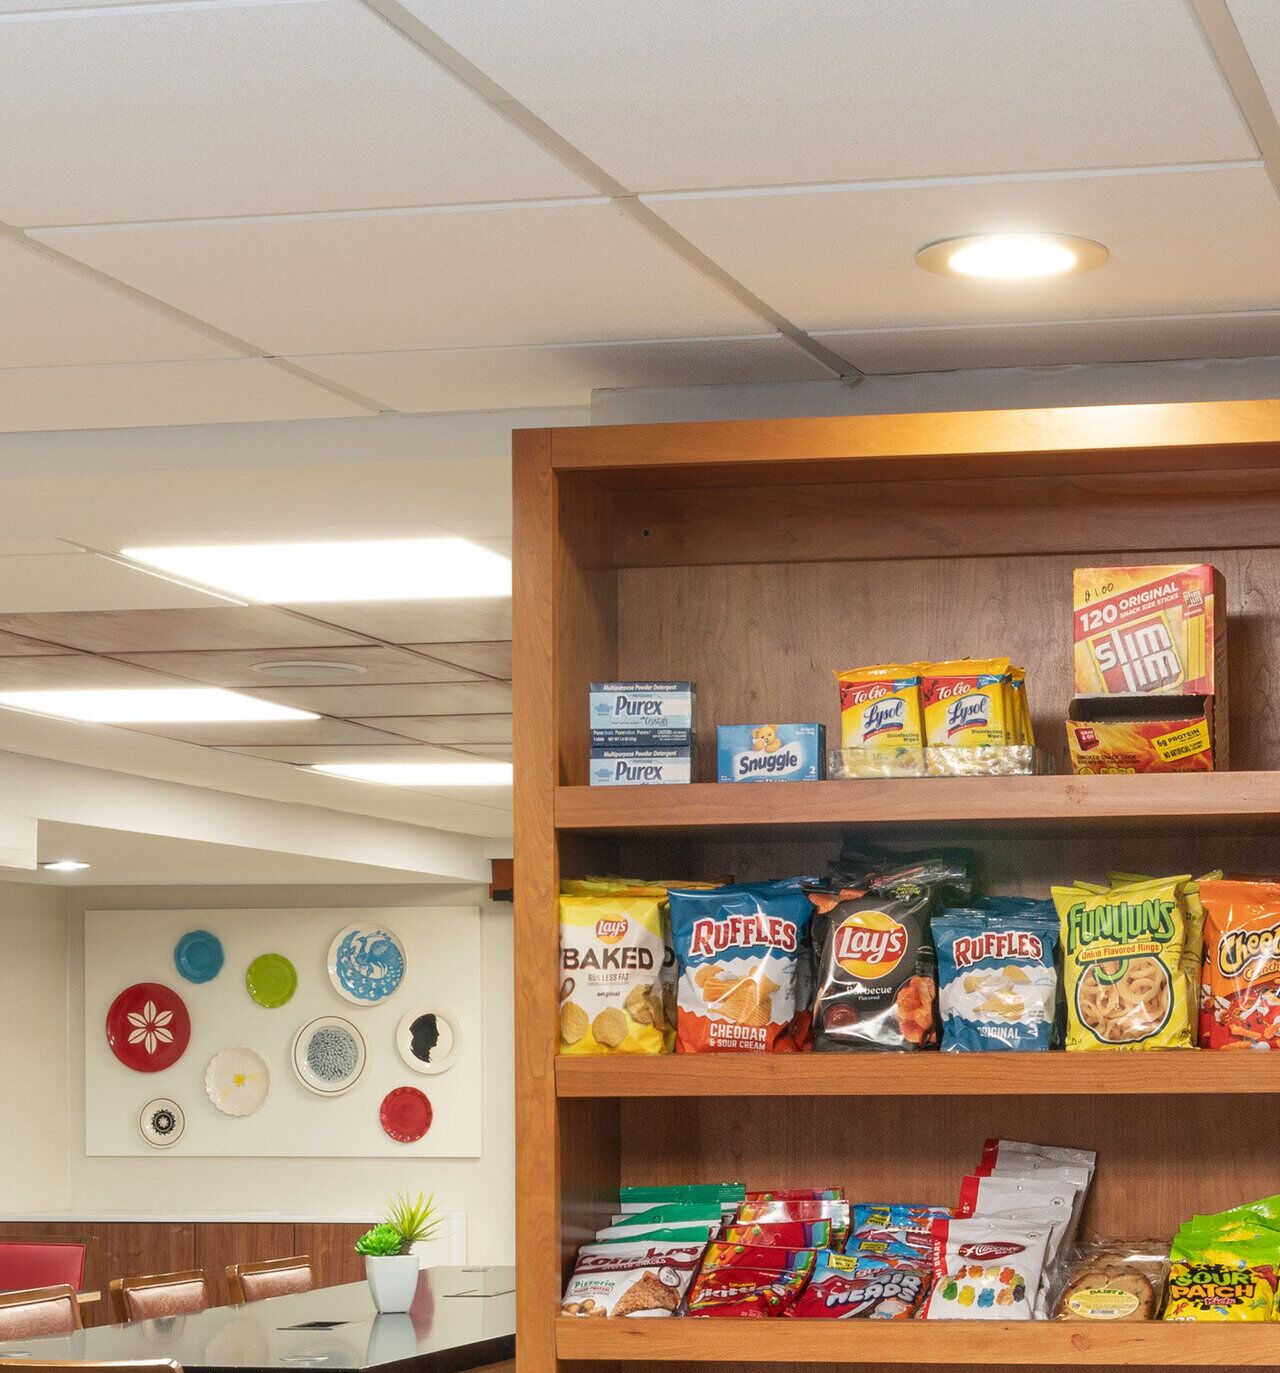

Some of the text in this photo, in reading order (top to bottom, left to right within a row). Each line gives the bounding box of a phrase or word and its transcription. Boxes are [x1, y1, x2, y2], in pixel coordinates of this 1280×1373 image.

[1079, 604, 1118, 632] 120
[1119, 582, 1179, 610] ORIGINAL
[852, 686, 887, 704] To Go
[936, 681, 971, 701] To Go
[615, 695, 662, 715] Purex
[863, 700, 904, 729] Lysol
[947, 696, 988, 725] Lysol
[1168, 728, 1200, 743] PROTEIN
[615, 761, 662, 781] Purex
[739, 750, 798, 775] Snuggle
[597, 917, 628, 937] Lay's
[689, 913, 797, 957] RUFFLES
[838, 927, 904, 964] Lay's
[954, 931, 1043, 970] RUFFLES
[1103, 945, 1137, 957] Flavored
[1138, 942, 1159, 954] Rings
[563, 947, 654, 970] BAKED
[602, 973, 616, 982] LESS
[597, 990, 621, 998] original
[709, 1023, 767, 1041] CHEDDAR
[717, 1038, 766, 1051] SOUR CREAM
[1175, 1271, 1250, 1287] SOUR
[1171, 1283, 1256, 1299] PATCH
